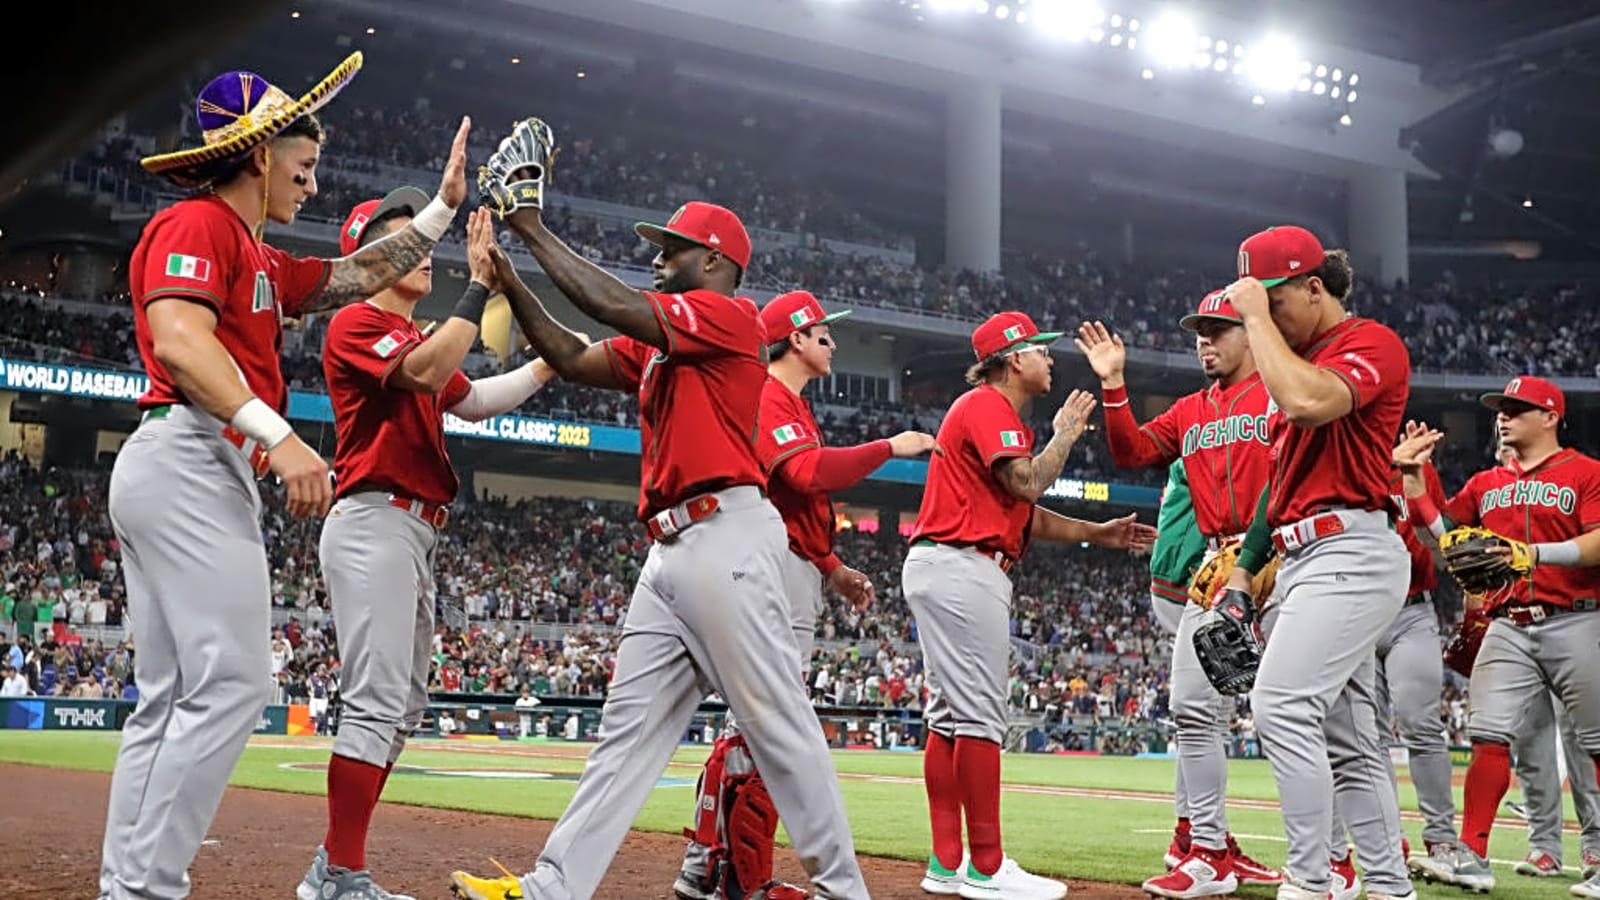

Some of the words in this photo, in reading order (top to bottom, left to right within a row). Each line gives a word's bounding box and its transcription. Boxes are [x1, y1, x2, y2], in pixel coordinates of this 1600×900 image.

[7, 363, 70, 392] WORLD
[500, 418, 556, 443] CLASSIC
[557, 424, 590, 446] 2023
[1182, 413, 1270, 457] MEXICO
[1043, 478, 1083, 499] LASSIC
[1479, 479, 1576, 516] MEXICO
[54, 707, 105, 727] THK
